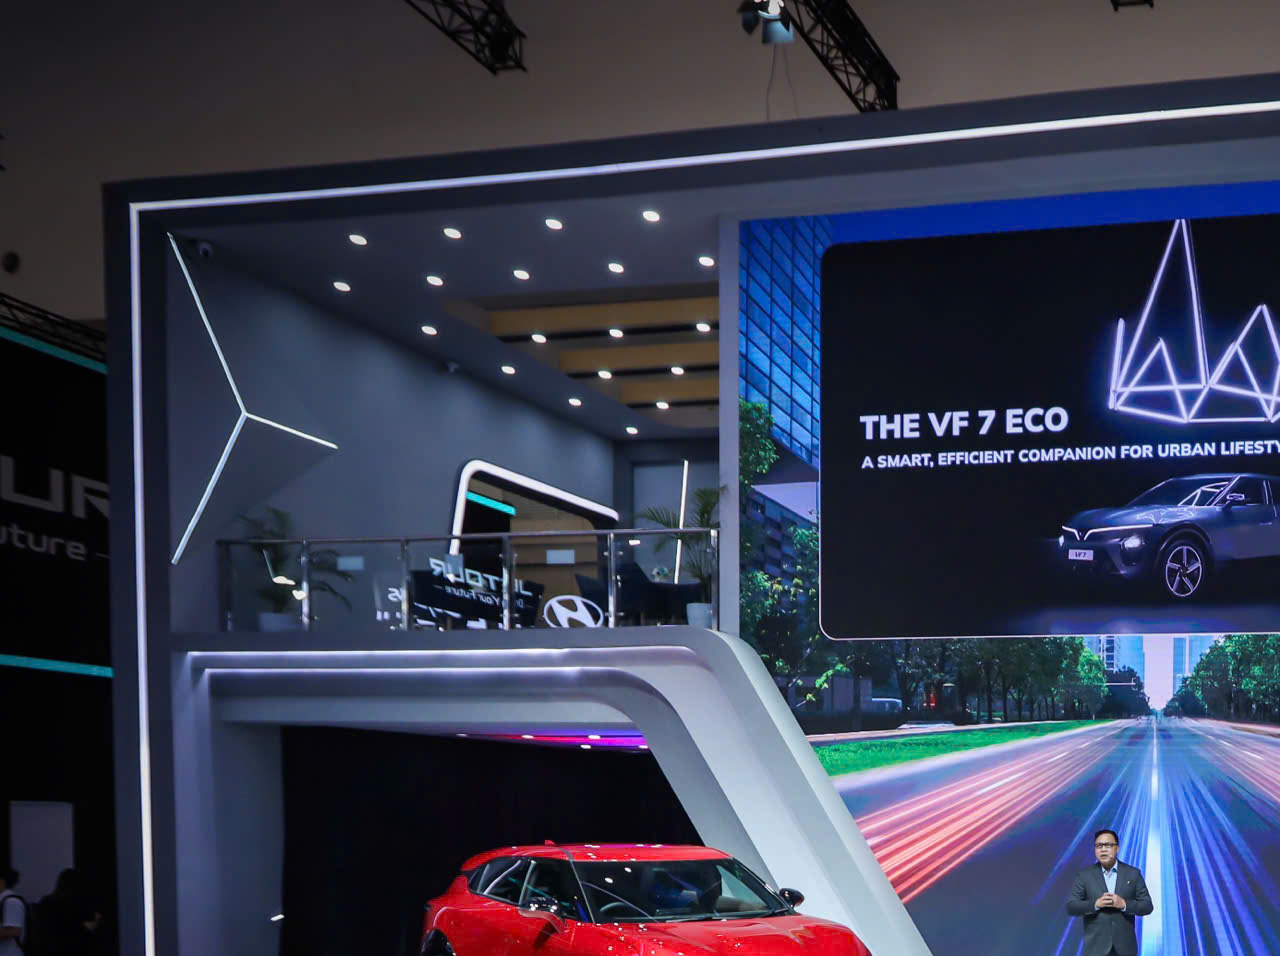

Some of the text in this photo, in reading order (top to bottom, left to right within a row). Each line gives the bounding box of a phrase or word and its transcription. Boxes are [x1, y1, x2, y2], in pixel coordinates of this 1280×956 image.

[859, 406, 1069, 440] THE VF 7 ECO
[861, 456, 874, 469] A
[877, 453, 934, 468] SMART,
[938, 450, 1014, 466] EFFICIENT
[1018, 445, 1116, 463] COMPANION
[1120, 444, 1153, 460] FOR
[1157, 442, 1216, 457] URBAN
